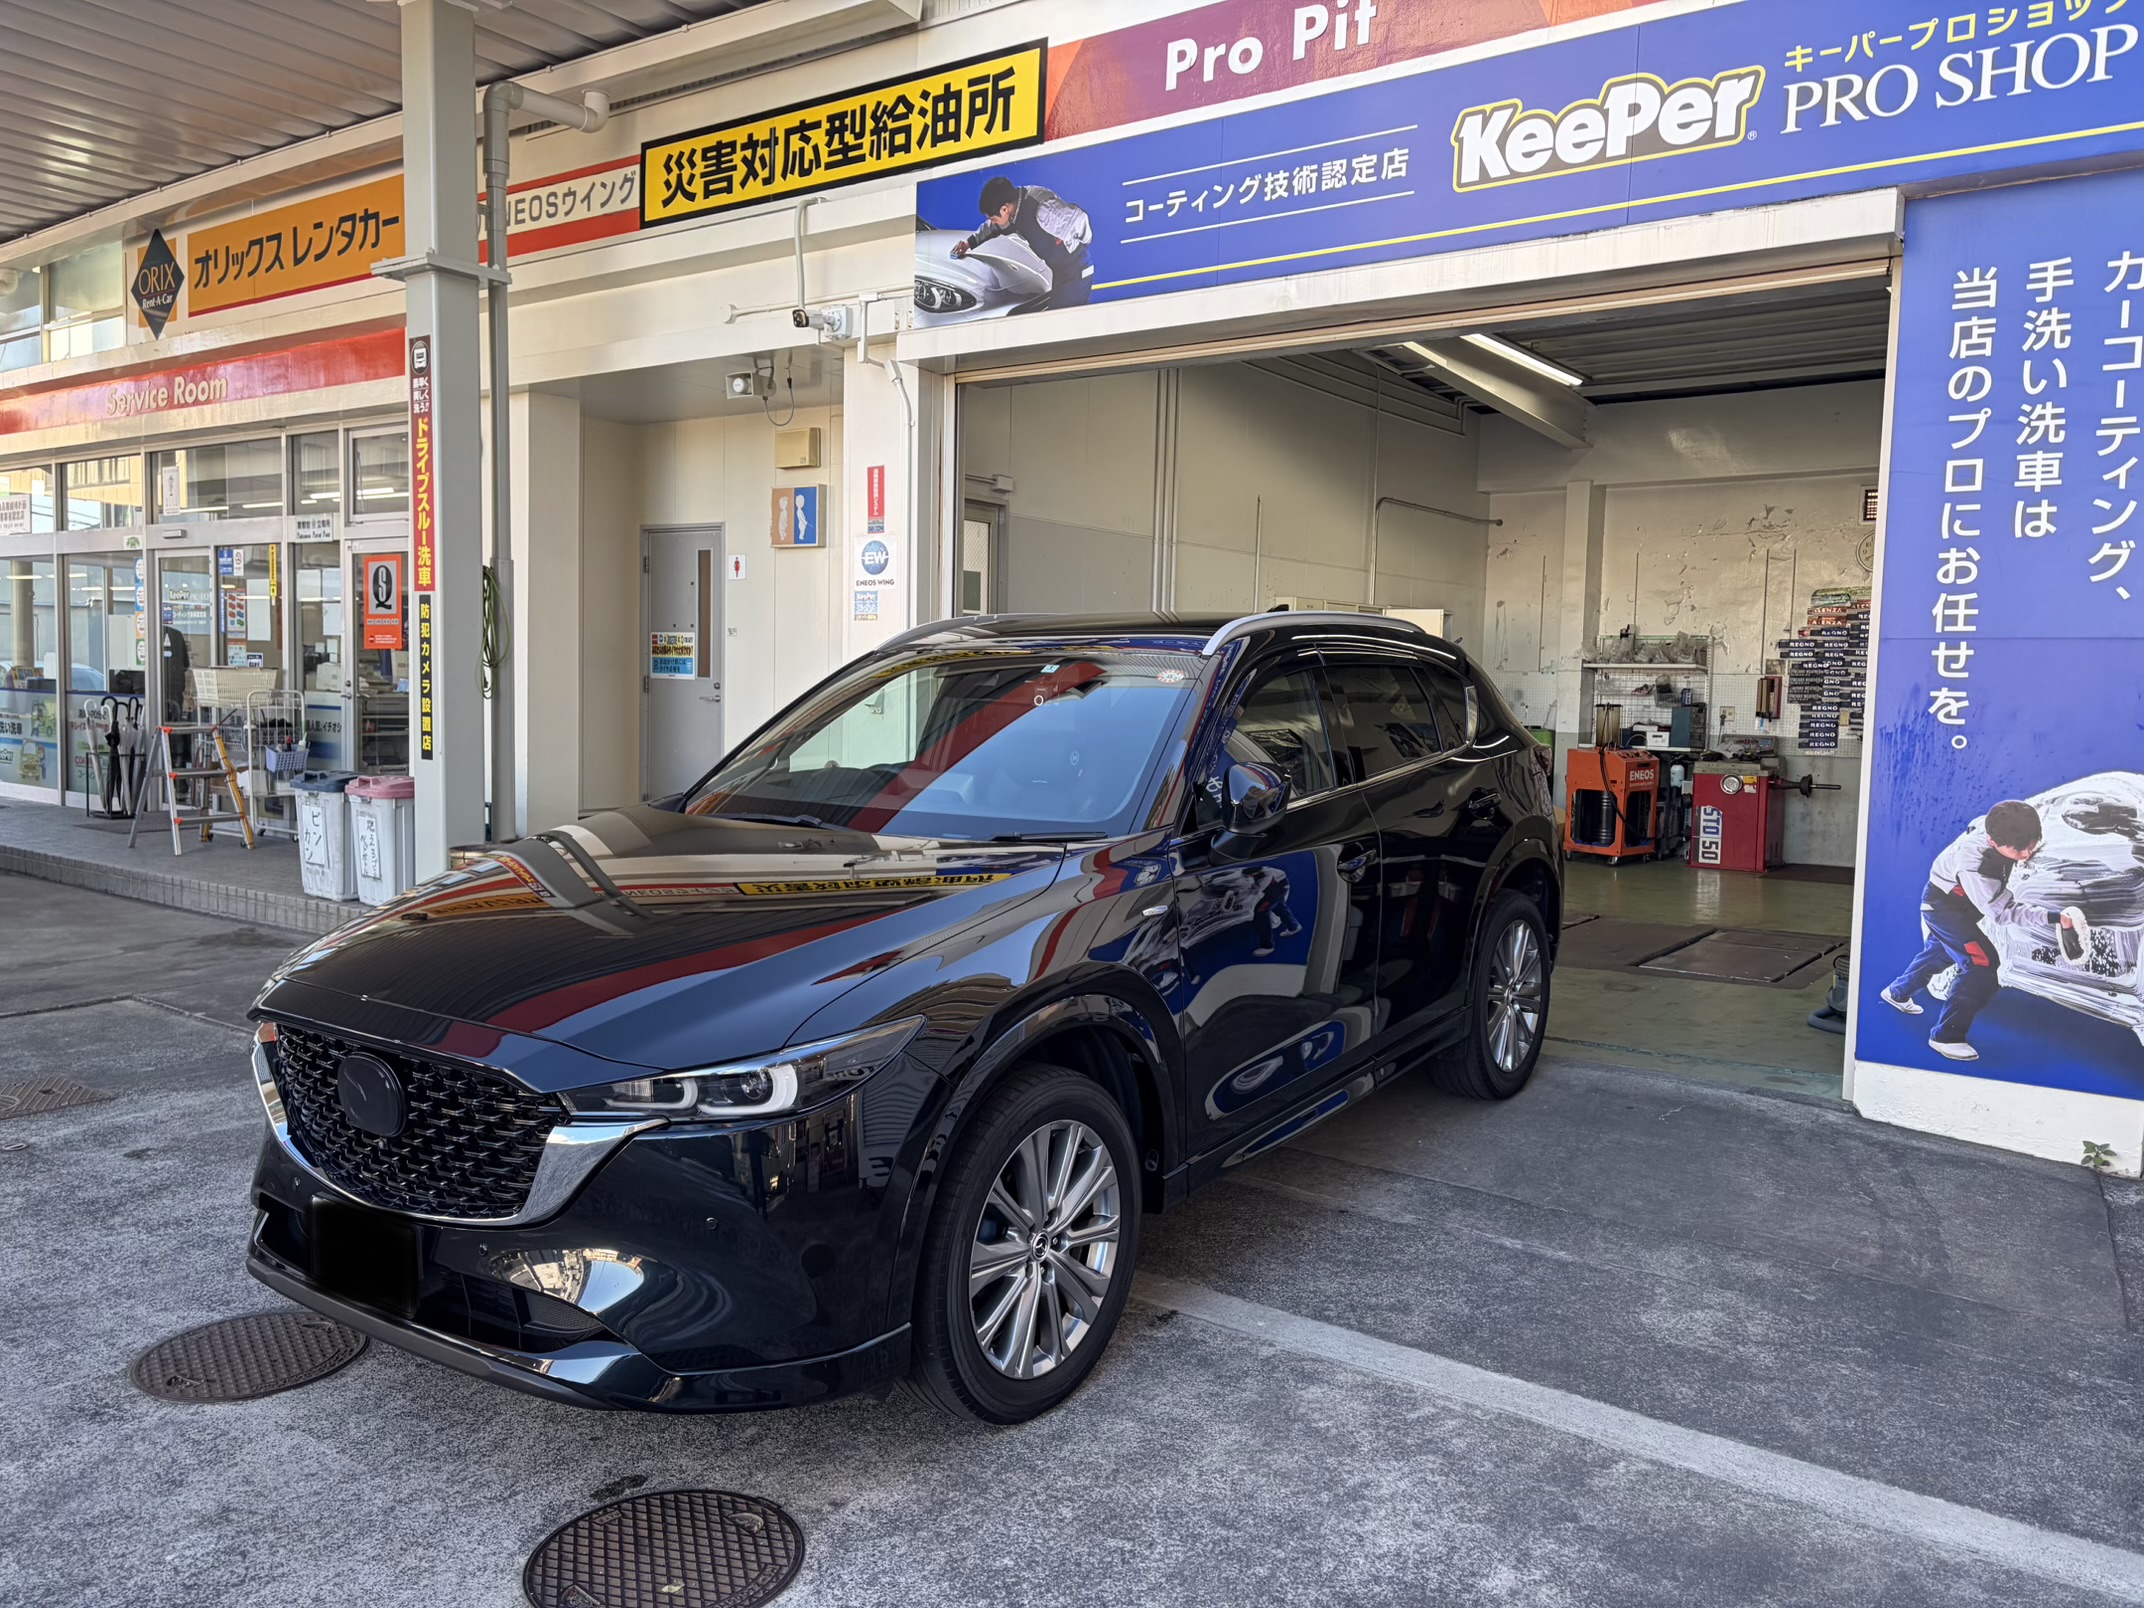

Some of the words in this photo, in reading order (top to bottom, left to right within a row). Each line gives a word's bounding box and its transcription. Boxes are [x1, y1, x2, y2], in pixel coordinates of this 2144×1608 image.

[1165, 36, 1264, 91] Pro
[1292, 0, 1378, 61] Pit
[1780, 64, 1919, 135] PRO
[1935, 23, 2139, 109] SHOP
[661, 66, 1015, 208] 災害対応型給油所
[1125, 148, 1409, 223] コーティング技術認定店
[1455, 70, 1760, 187] KeePer
[138, 261, 176, 296] ORIX
[108, 381, 169, 416] Service
[174, 376, 228, 405] Room
[2014, 257, 2074, 538] 手洗い洗車は
[416, 417, 432, 587] ドライブスルー洗車
[1928, 266, 1997, 749] 当店のプロにお任せを。
[420, 603, 432, 751] 防犯カメラ設置店
[1629, 769, 1654, 781] ENEOS
